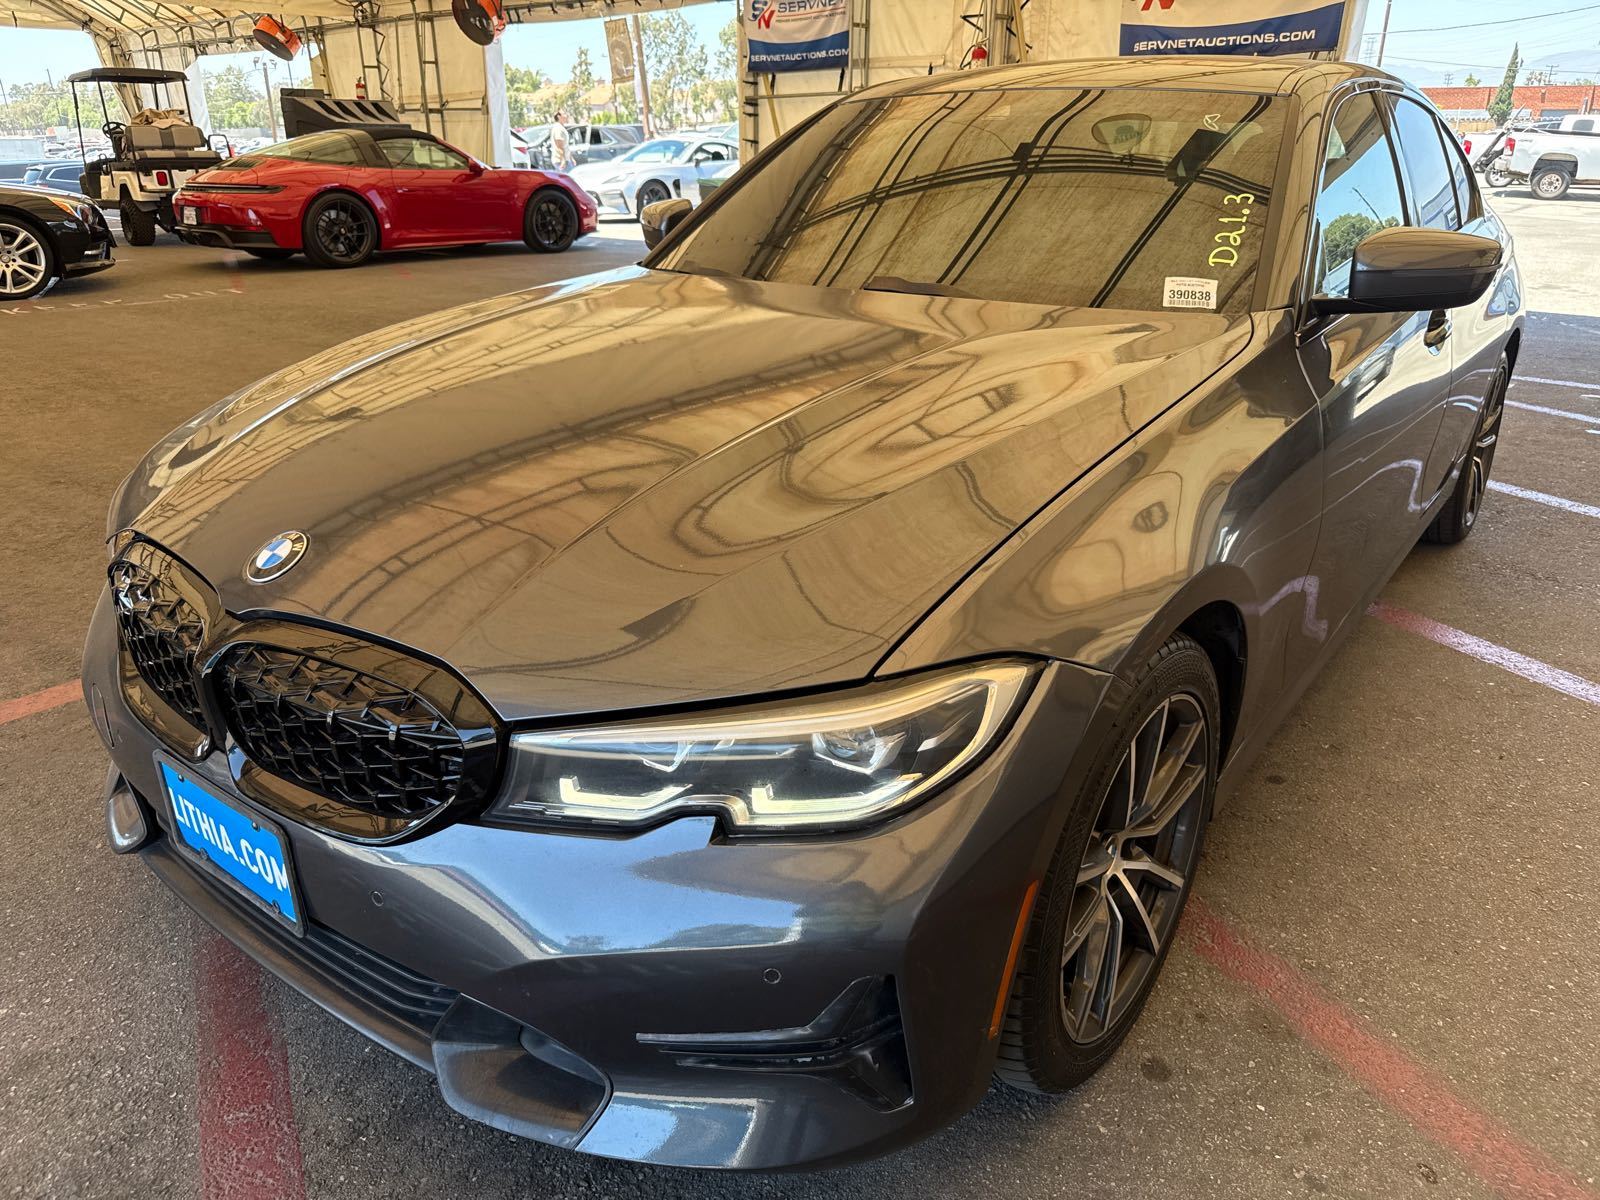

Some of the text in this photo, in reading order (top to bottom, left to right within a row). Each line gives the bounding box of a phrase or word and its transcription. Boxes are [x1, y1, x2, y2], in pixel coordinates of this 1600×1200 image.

[1133, 29, 1316, 52] SERVNETAUCTIONS.COM
[750, 48, 849, 62] SERVNETAUCTIONS.COM
[1208, 193, 1255, 267] D21.3
[1168, 289, 1211, 301] 390838
[168, 787, 291, 893] LITHIA.COM
